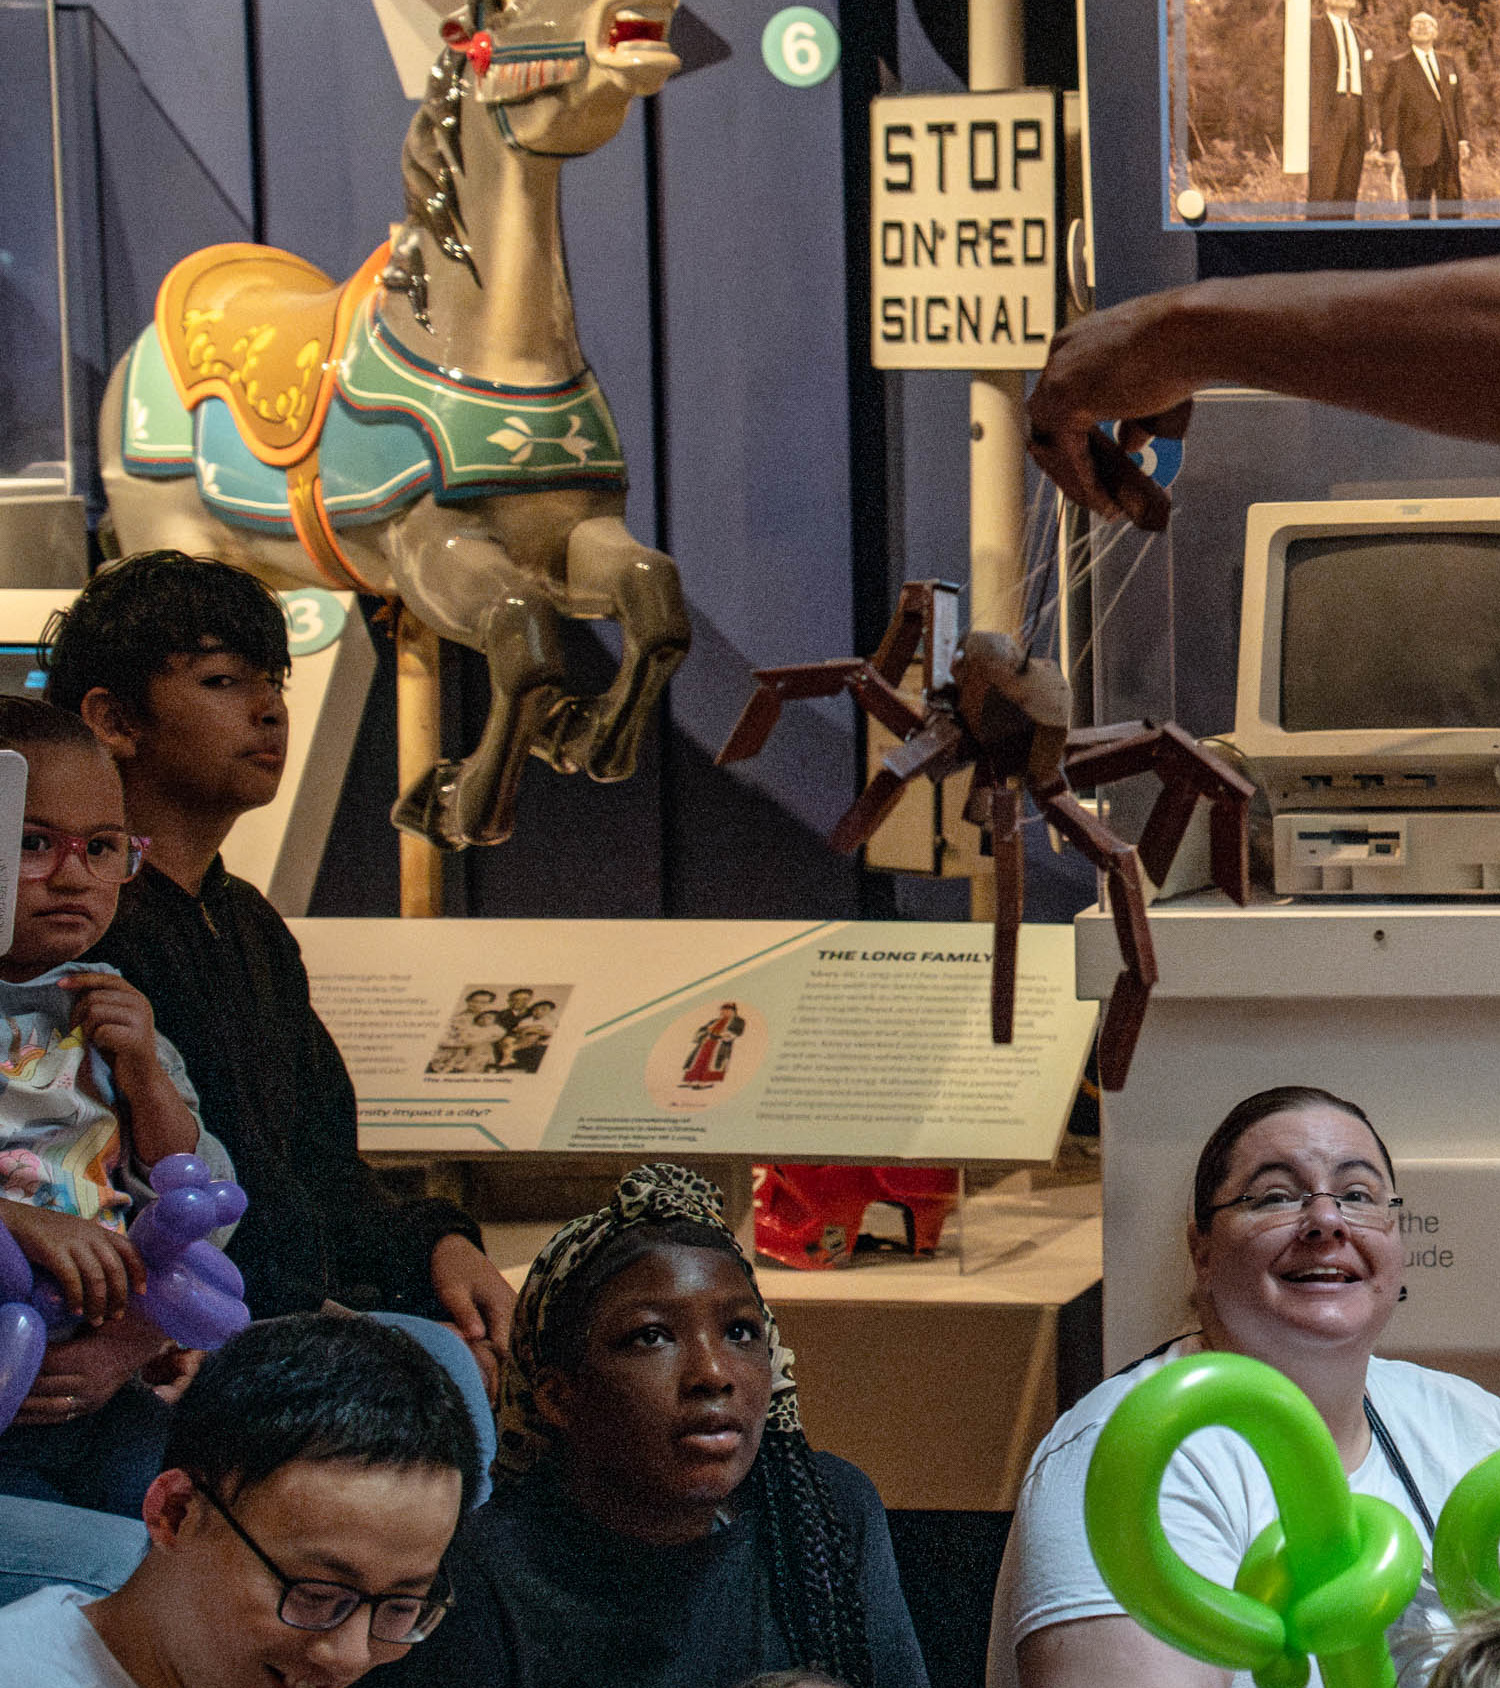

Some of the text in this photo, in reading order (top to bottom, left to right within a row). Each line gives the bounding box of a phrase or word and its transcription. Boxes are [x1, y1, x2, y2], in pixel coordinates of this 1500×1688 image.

[781, 22, 822, 76] 6
[883, 119, 1043, 193] STOP
[881, 218, 1047, 267] ON RED
[881, 295, 1047, 344] SIGNAL
[287, 597, 324, 641] 3
[818, 949, 993, 963] THE LONG FAMILY
[392, 1107, 442, 1118] impact
[457, 1107, 493, 1117] city?
[1398, 1210, 1439, 1234] the
[1404, 1243, 1454, 1269] uide
